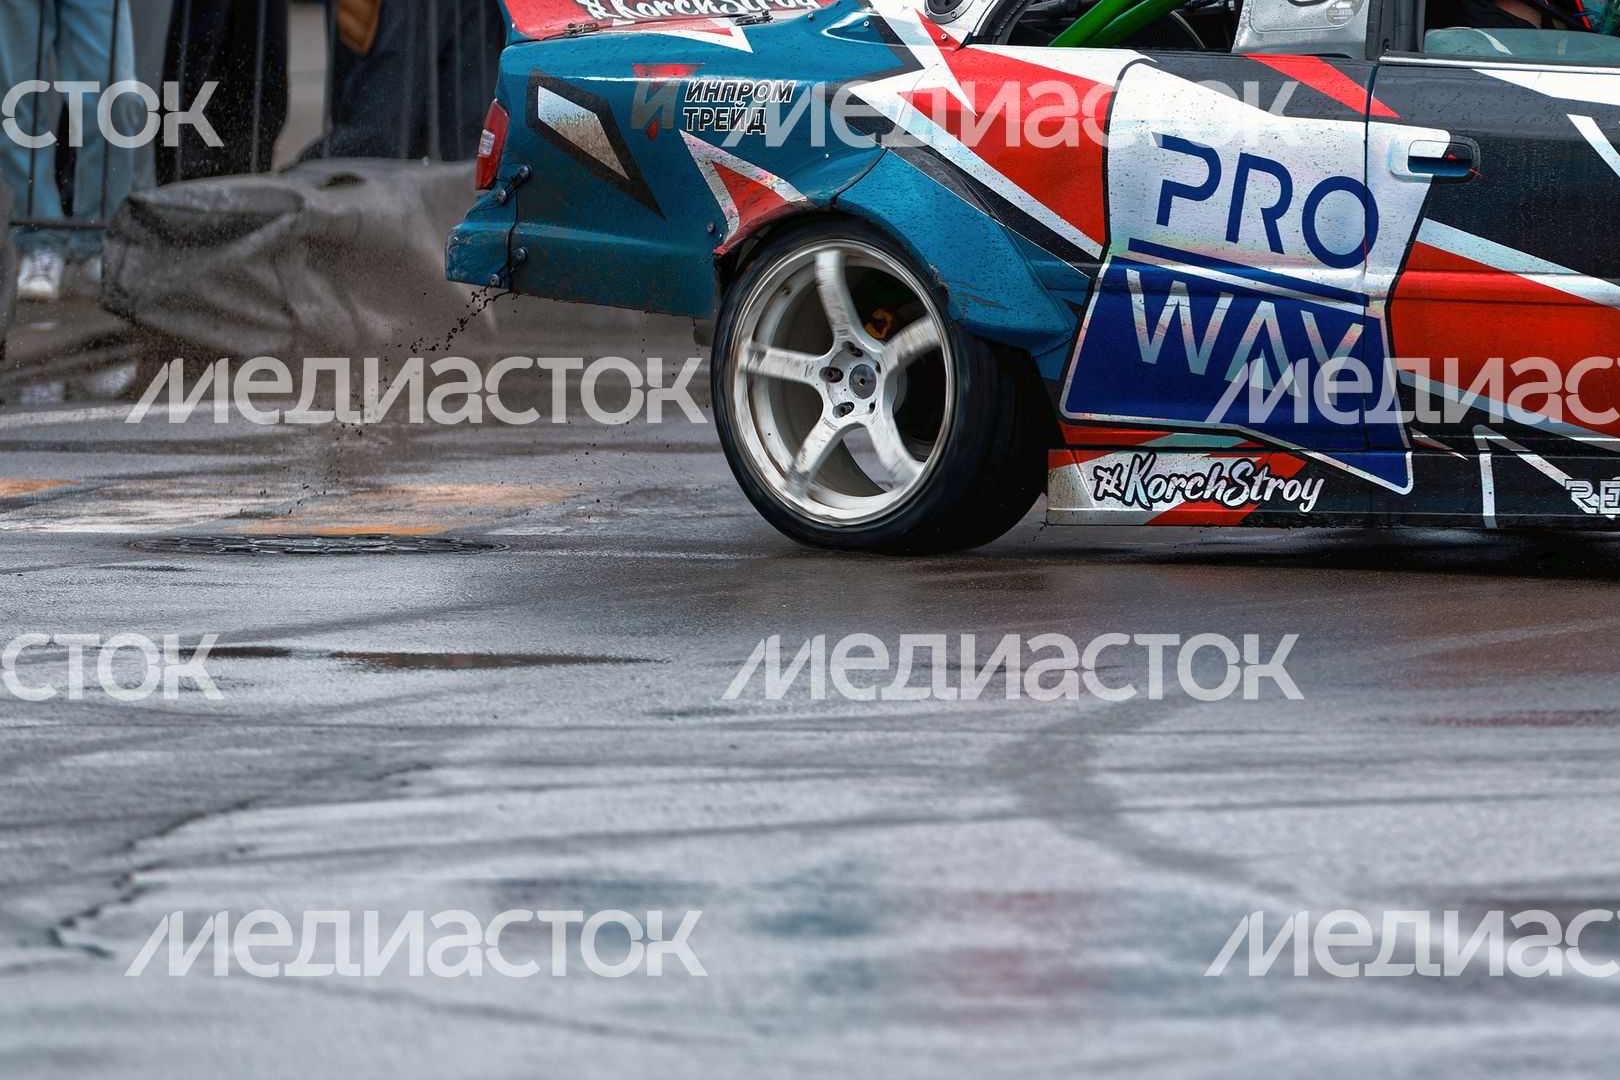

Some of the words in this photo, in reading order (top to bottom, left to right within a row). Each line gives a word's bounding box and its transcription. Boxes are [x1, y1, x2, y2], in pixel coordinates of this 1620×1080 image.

[683, 101, 767, 135] ТРЕЙД
[684, 80, 797, 104] ИНПРОМ
[1150, 132, 1379, 269] PRO
[1126, 269, 1363, 405] WAY
[1095, 454, 1325, 513] #KorchStroy
